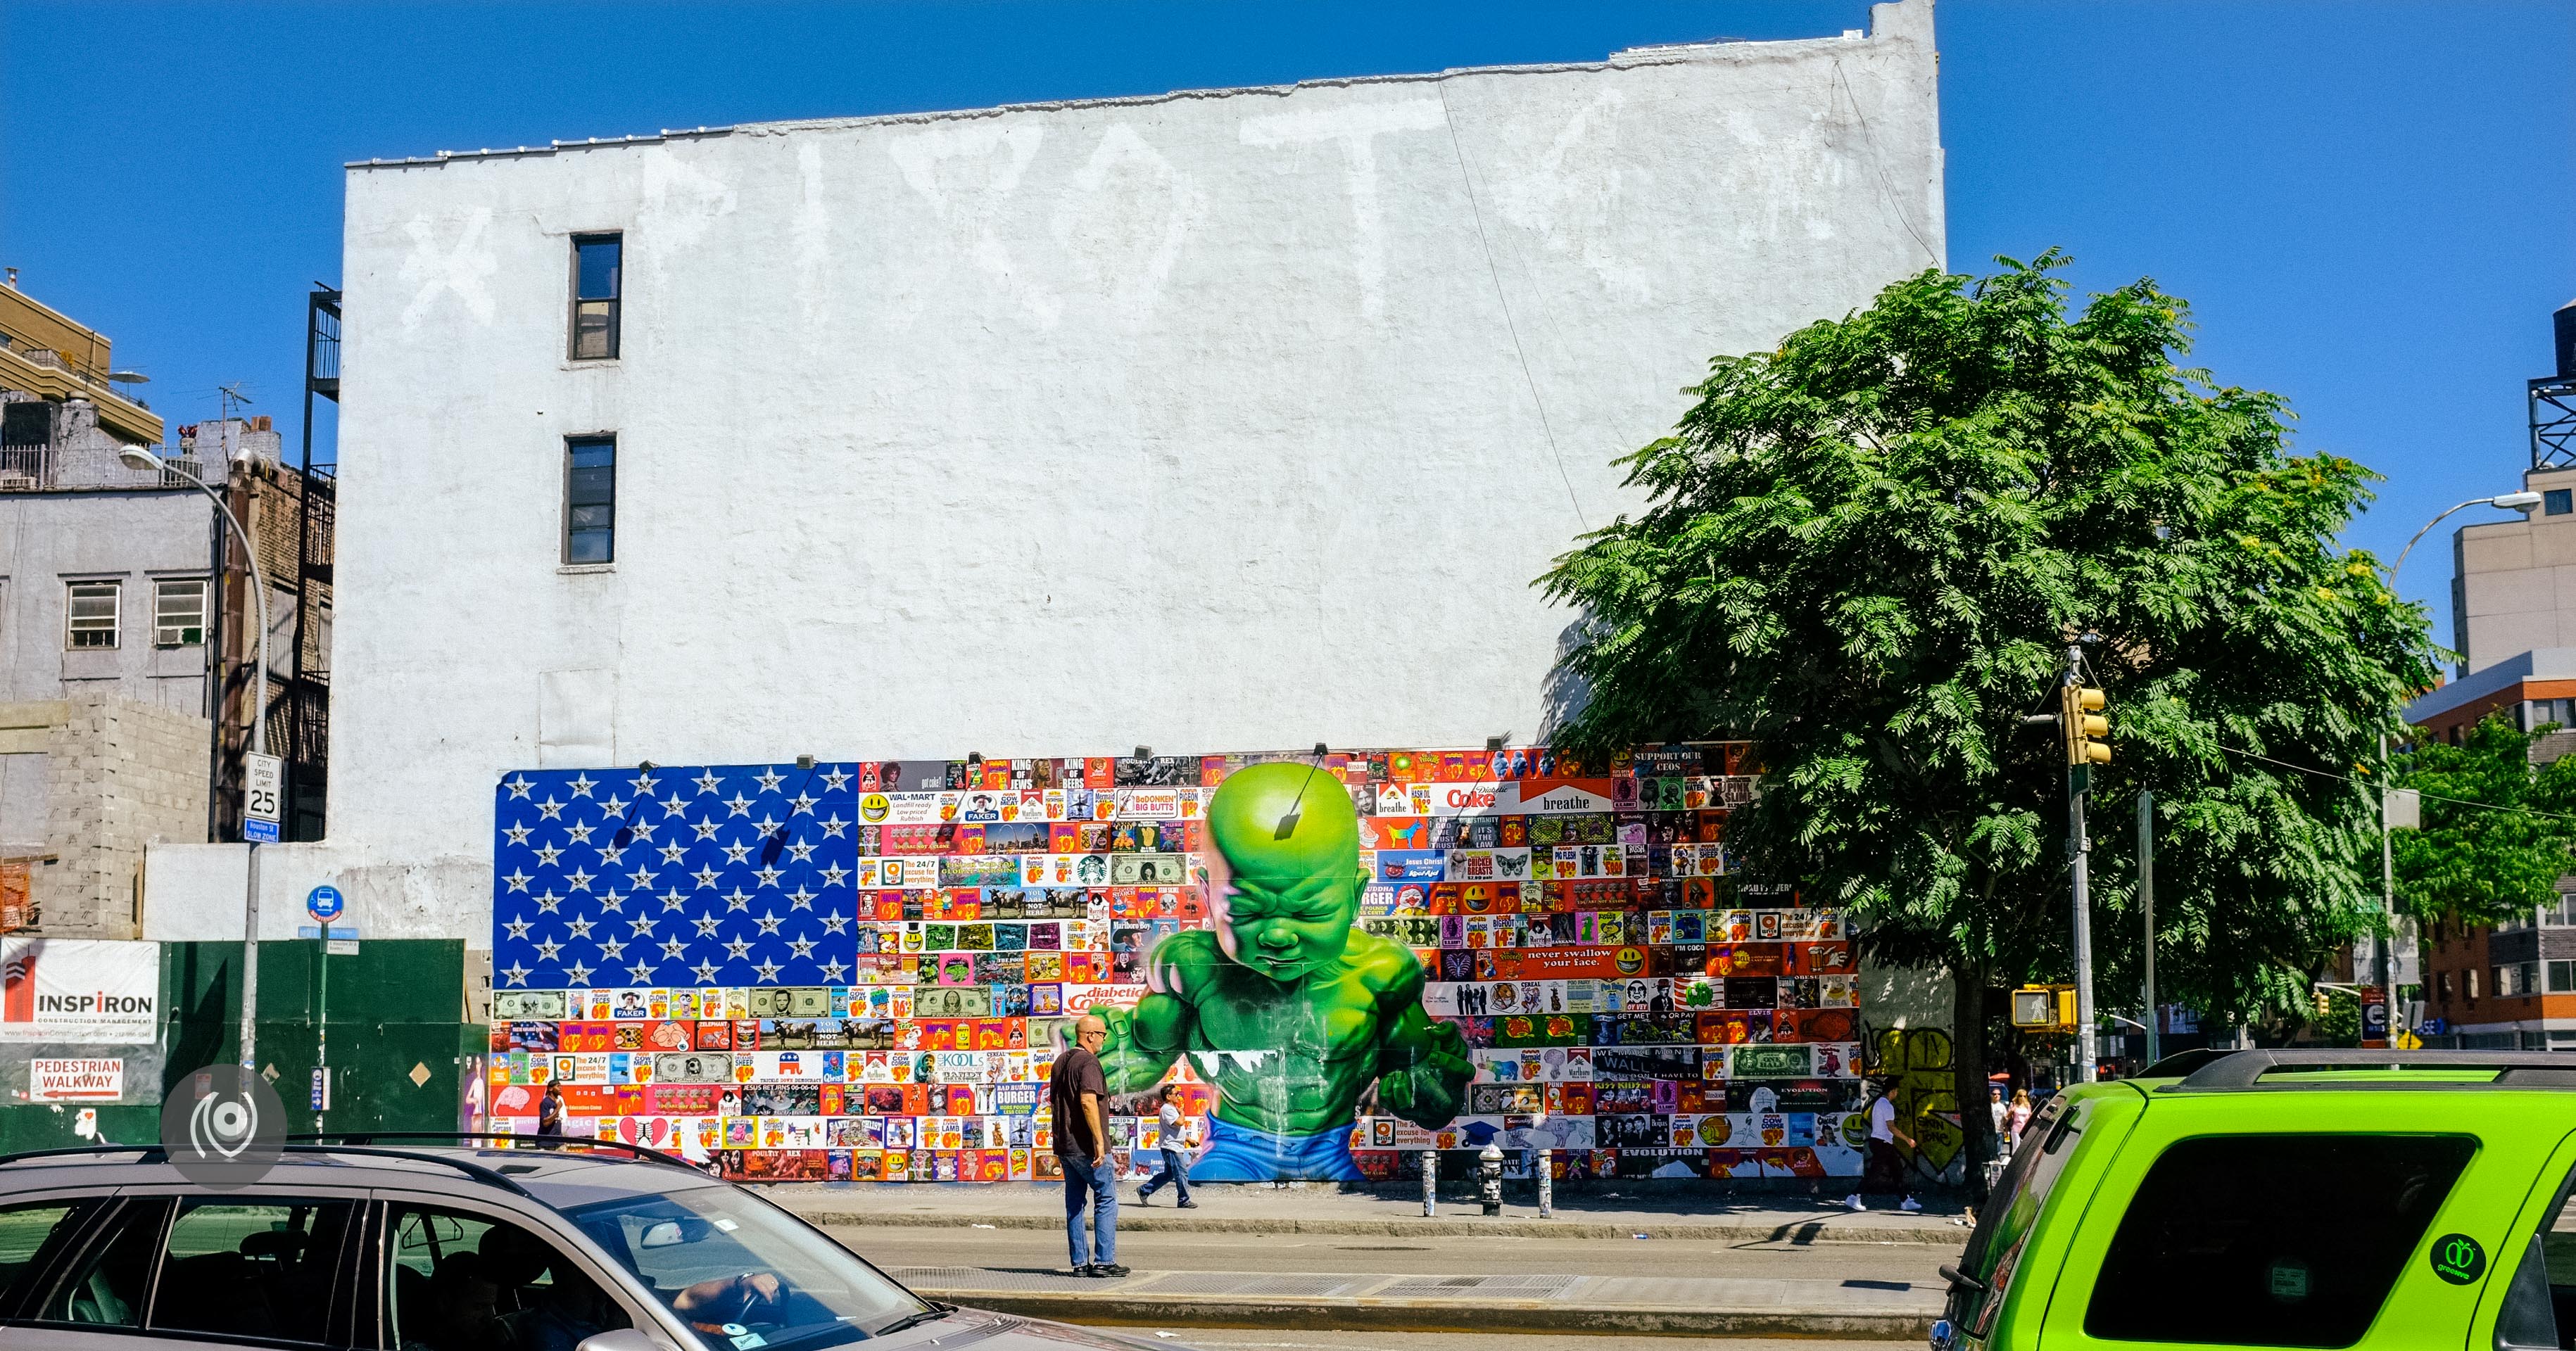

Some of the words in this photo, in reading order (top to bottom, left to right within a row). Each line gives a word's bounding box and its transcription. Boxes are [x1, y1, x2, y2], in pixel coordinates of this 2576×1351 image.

[257, 759, 271, 768] CITY
[1011, 759, 1031, 770] KING
[1064, 758, 1085, 769] KING
[254, 768, 274, 779] SPEED
[1016, 770, 1025, 779] OF
[1069, 769, 1078, 778] OF
[255, 779, 272, 788] LIMIT
[1010, 779, 1033, 790] JEWS
[1062, 778, 1084, 789] BEERS
[1727, 782, 1750, 792] PINK
[251, 789, 274, 813] 25
[1179, 793, 1199, 801] PIGEON
[1447, 789, 1496, 808] Coke
[1725, 792, 1752, 803] SLIME
[1379, 801, 1406, 813] breathe
[1543, 796, 1590, 811] breathe
[247, 830, 261, 839] SLOW
[262, 832, 277, 842] ZONE
[1628, 844, 1645, 853] RUSH
[1563, 851, 1577, 860] FLESH
[1467, 858, 1492, 867] CHICKEN
[1467, 866, 1493, 875] BREASTS
[904, 876, 935, 884] everything
[1113, 921, 1139, 930] Marlboro
[1139, 922, 1151, 931] Boy
[1493, 919, 1515, 927] BIGFOOT
[1781, 929, 1815, 937] everything
[1528, 951, 1560, 959] never
[1564, 949, 1612, 957] swallow
[1543, 958, 1570, 968] your
[1574, 957, 1600, 966] face.
[1087, 987, 1145, 998] diabetic
[35, 1060, 120, 1072] PEDESTRIAN
[1605, 1056, 1650, 1073] WALL
[576, 1072, 606, 1080] everything
[42, 1076, 113, 1088] WALKWAY
[997, 1091, 1036, 1104] BURGER
[1396, 1136, 1430, 1145] everything
